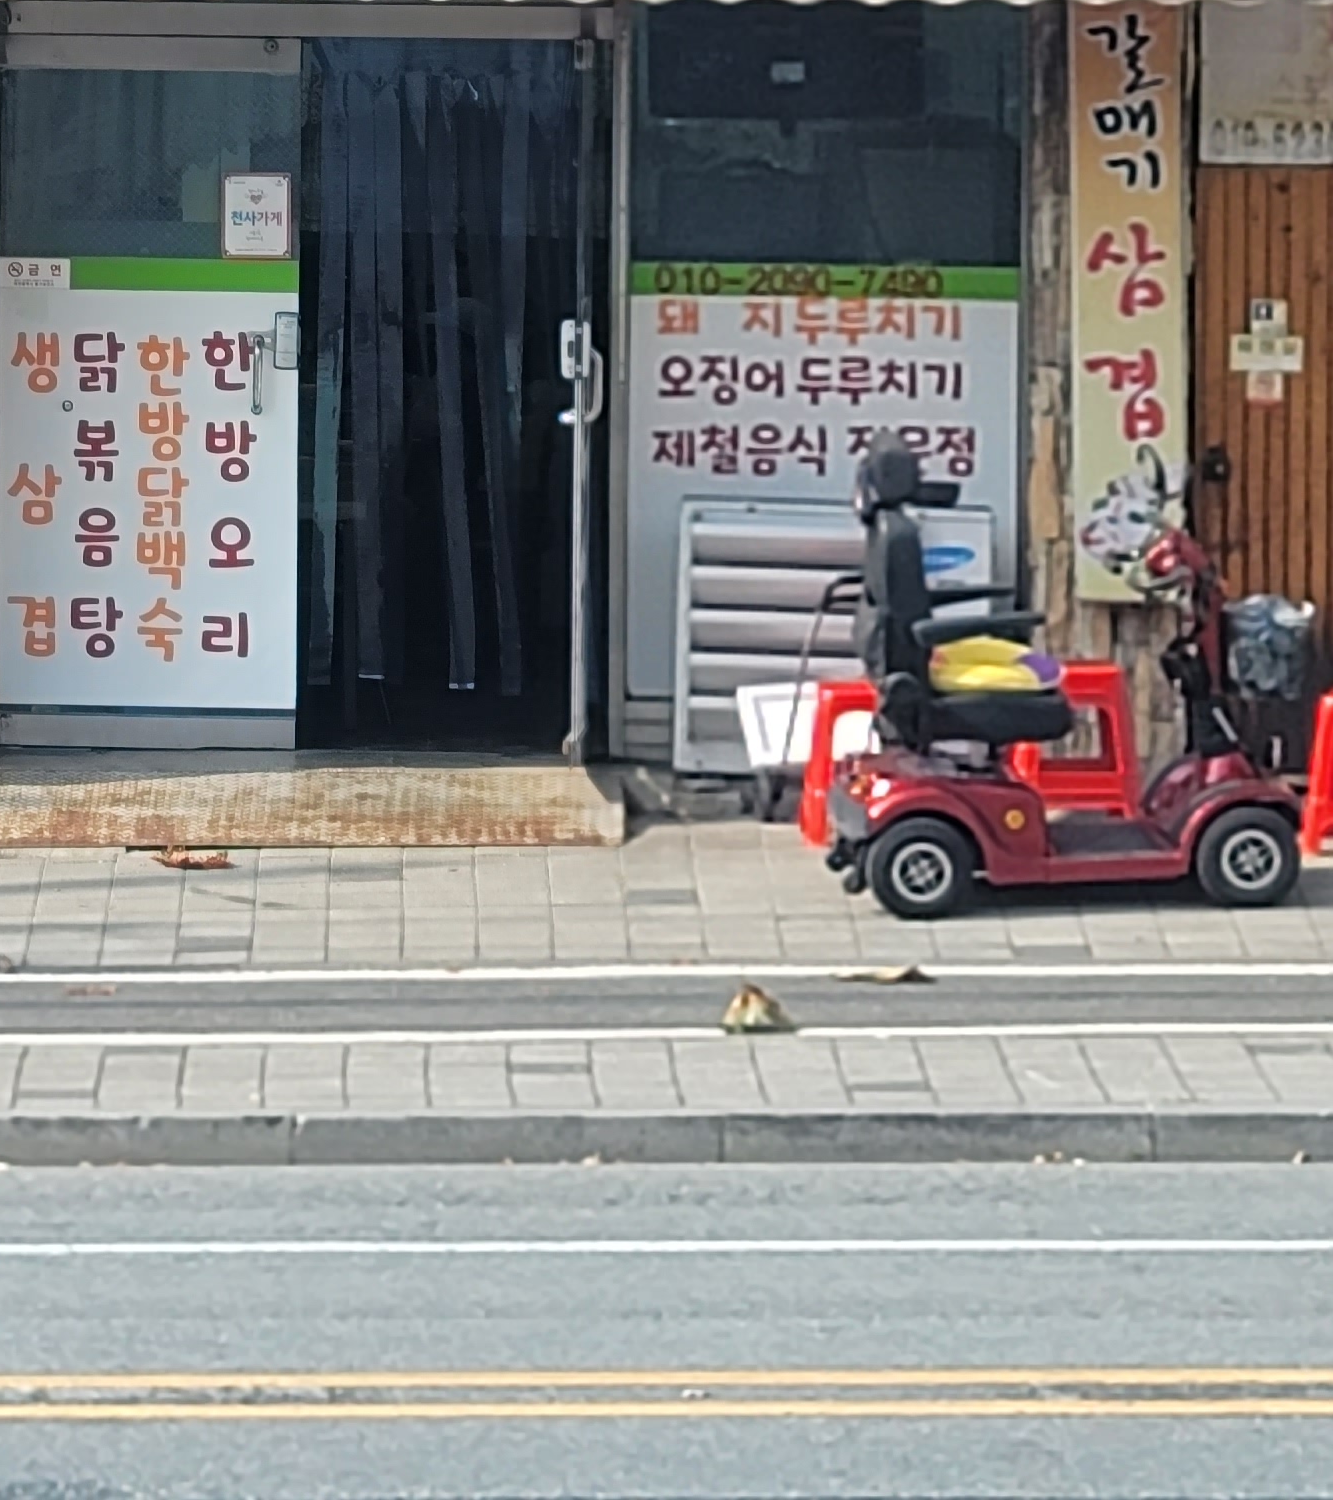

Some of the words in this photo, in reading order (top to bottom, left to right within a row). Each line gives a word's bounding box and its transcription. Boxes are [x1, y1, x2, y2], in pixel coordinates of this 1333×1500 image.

[231, 210, 283, 227] 천사가게
[1087, 14, 1165, 189] 갈매기
[652, 423, 828, 476] 제철음식
[1084, 222, 1166, 442] 삼겹
[6, 331, 61, 658] 생삼겹
[70, 331, 124, 658] 닭볶음탕
[136, 335, 191, 663] 한방닭백숙
[201, 330, 258, 659] 한방오리
